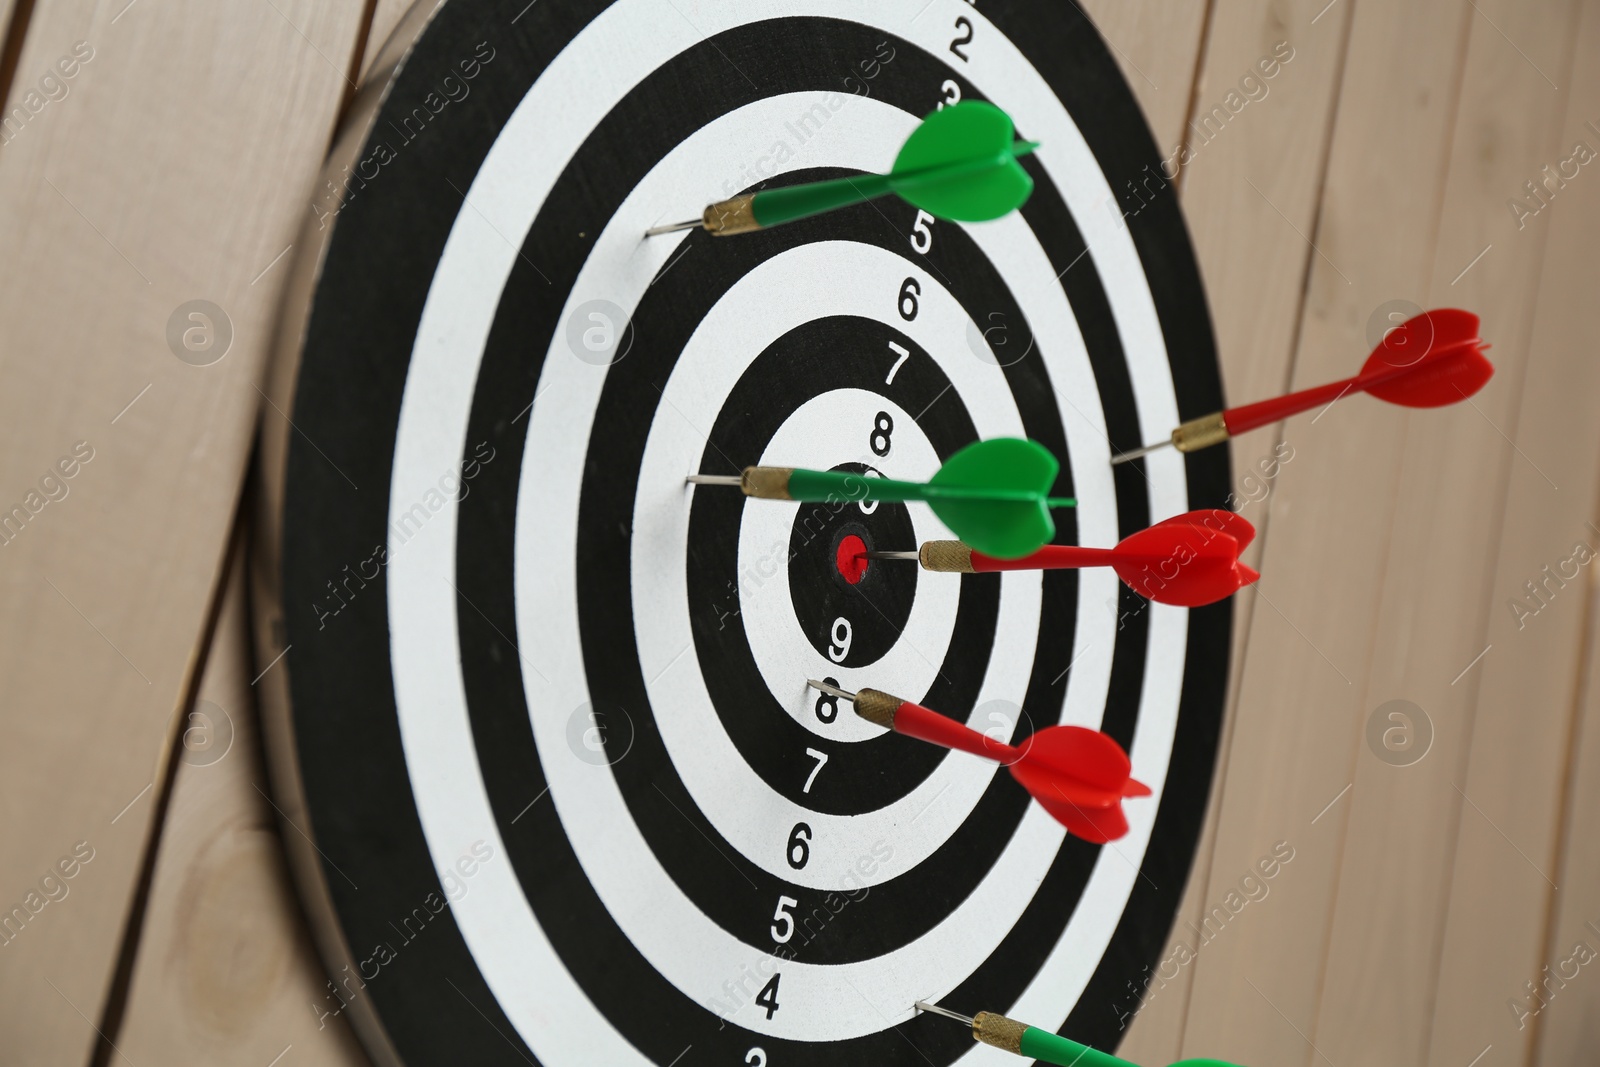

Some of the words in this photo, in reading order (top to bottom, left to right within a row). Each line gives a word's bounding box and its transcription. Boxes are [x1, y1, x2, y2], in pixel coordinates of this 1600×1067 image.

[949, 15, 974, 63] 2
[910, 208, 935, 255] 5
[897, 276, 921, 322] 6
[885, 341, 910, 386] 7
[869, 410, 894, 457] 8
[828, 616, 852, 663] 9
[815, 676, 840, 725] 8
[803, 747, 828, 793] 7
[786, 821, 812, 870] 6
[770, 895, 798, 944] 5
[755, 972, 781, 1021] 4
